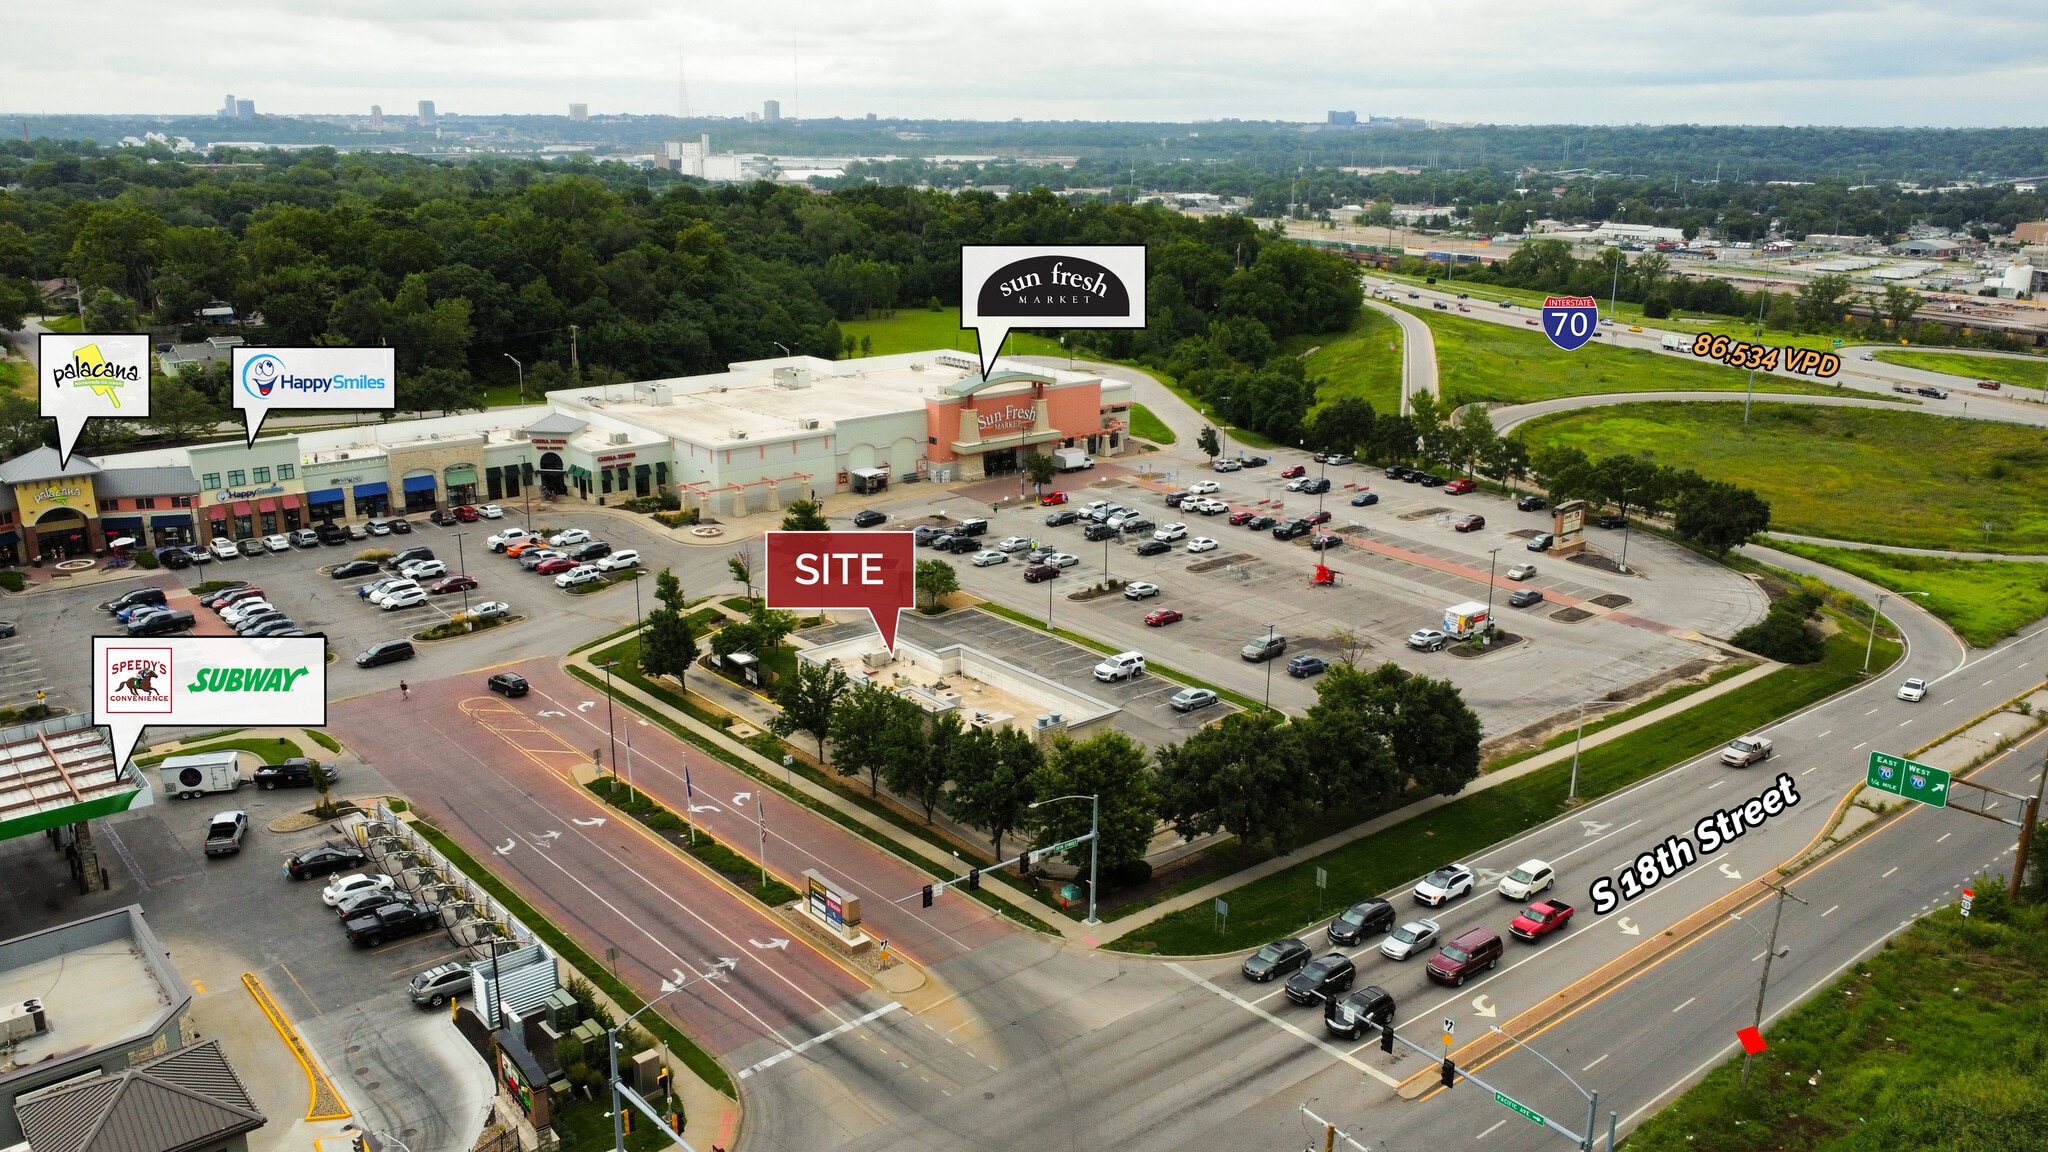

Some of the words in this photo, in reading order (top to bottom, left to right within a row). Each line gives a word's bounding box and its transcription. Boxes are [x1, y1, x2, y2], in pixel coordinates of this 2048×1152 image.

[977, 411, 1002, 430] Sun
[1005, 404, 1036, 421] Fresh
[995, 420, 1021, 430] MARKET
[34, 487, 81, 504] palacana
[1877, 755, 1898, 767] EAST
[1880, 768, 1892, 778] 70
[1908, 764, 1931, 776] WEST
[1882, 781, 1897, 791] MILE
[1912, 777, 1924, 787] 70
[1496, 1094, 1518, 1110] PACIFIC
